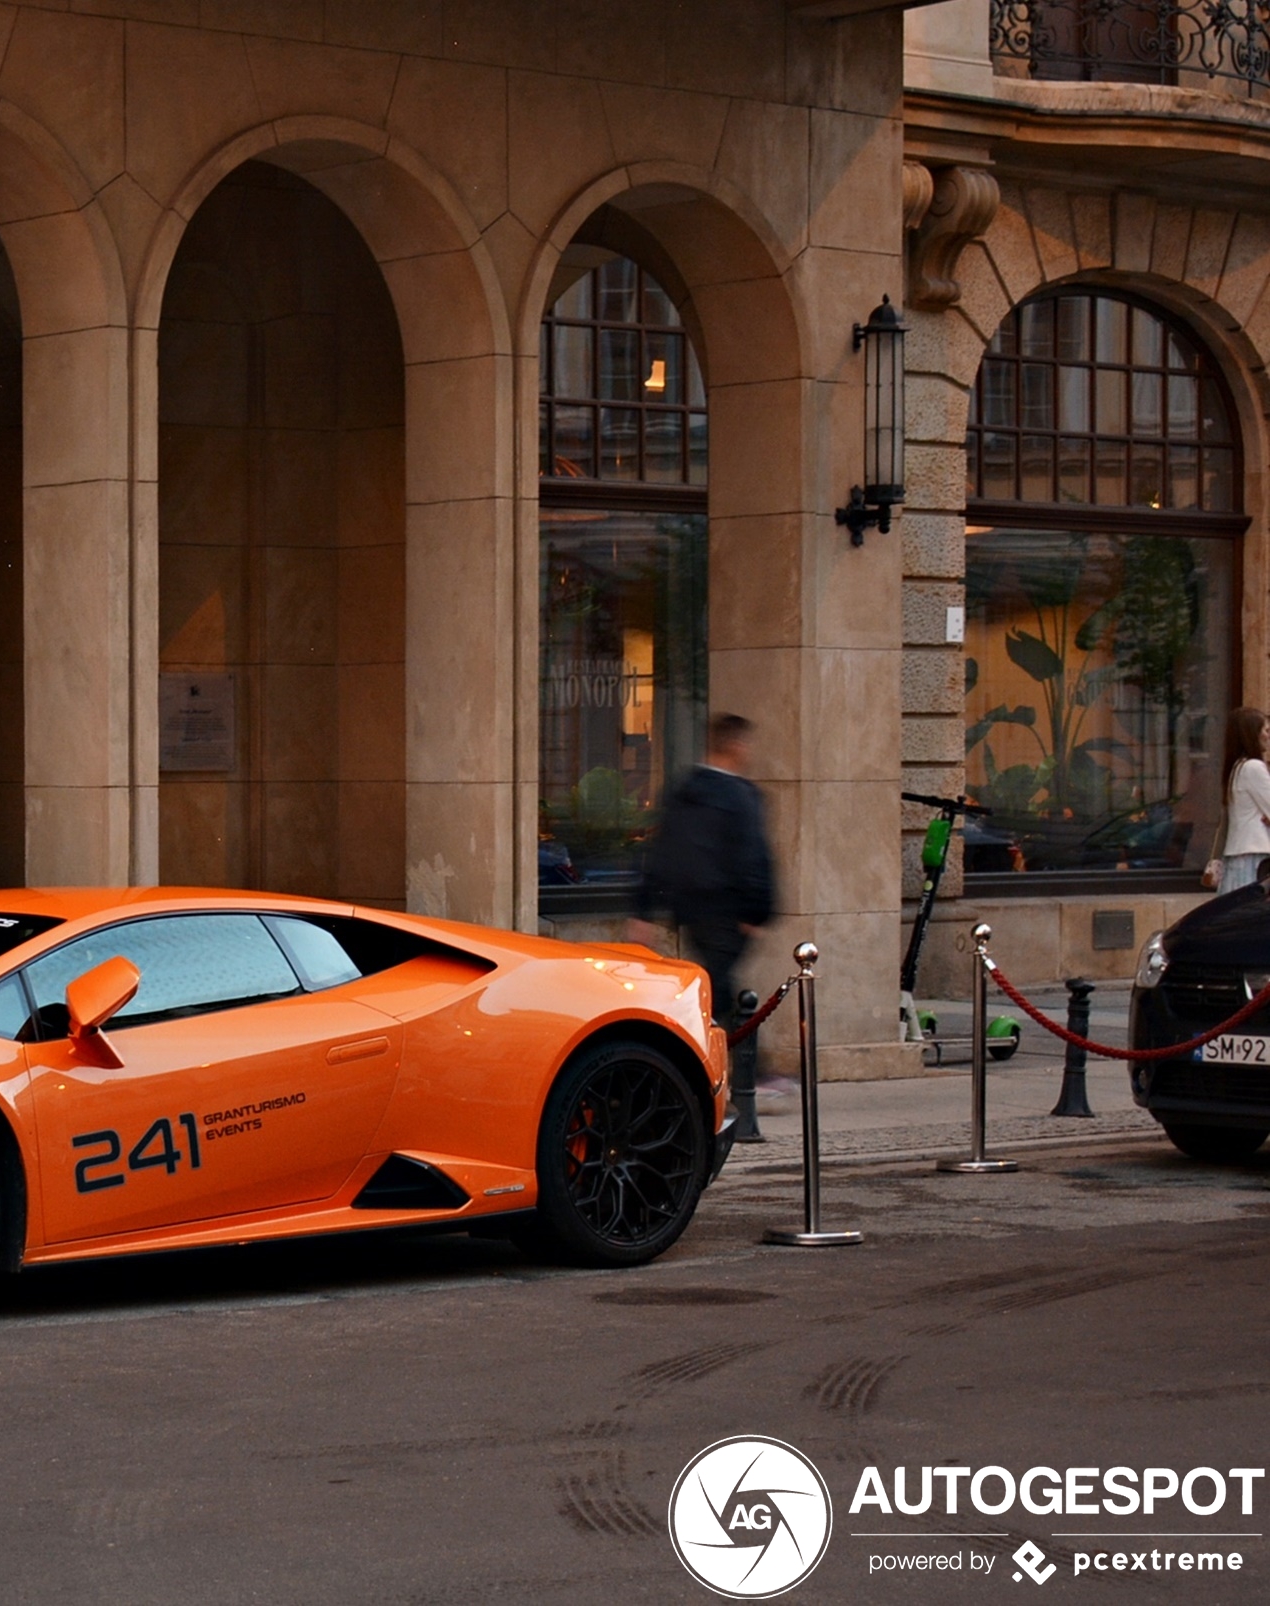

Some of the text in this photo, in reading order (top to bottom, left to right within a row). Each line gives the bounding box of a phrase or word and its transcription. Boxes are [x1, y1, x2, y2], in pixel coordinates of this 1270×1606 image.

[549, 664, 642, 708] MONOPOL
[1241, 1038, 1269, 1062] 92
[203, 1092, 307, 1126] GRANTURISMO
[205, 1118, 263, 1141] EVENTS
[71, 1112, 201, 1194] 241
